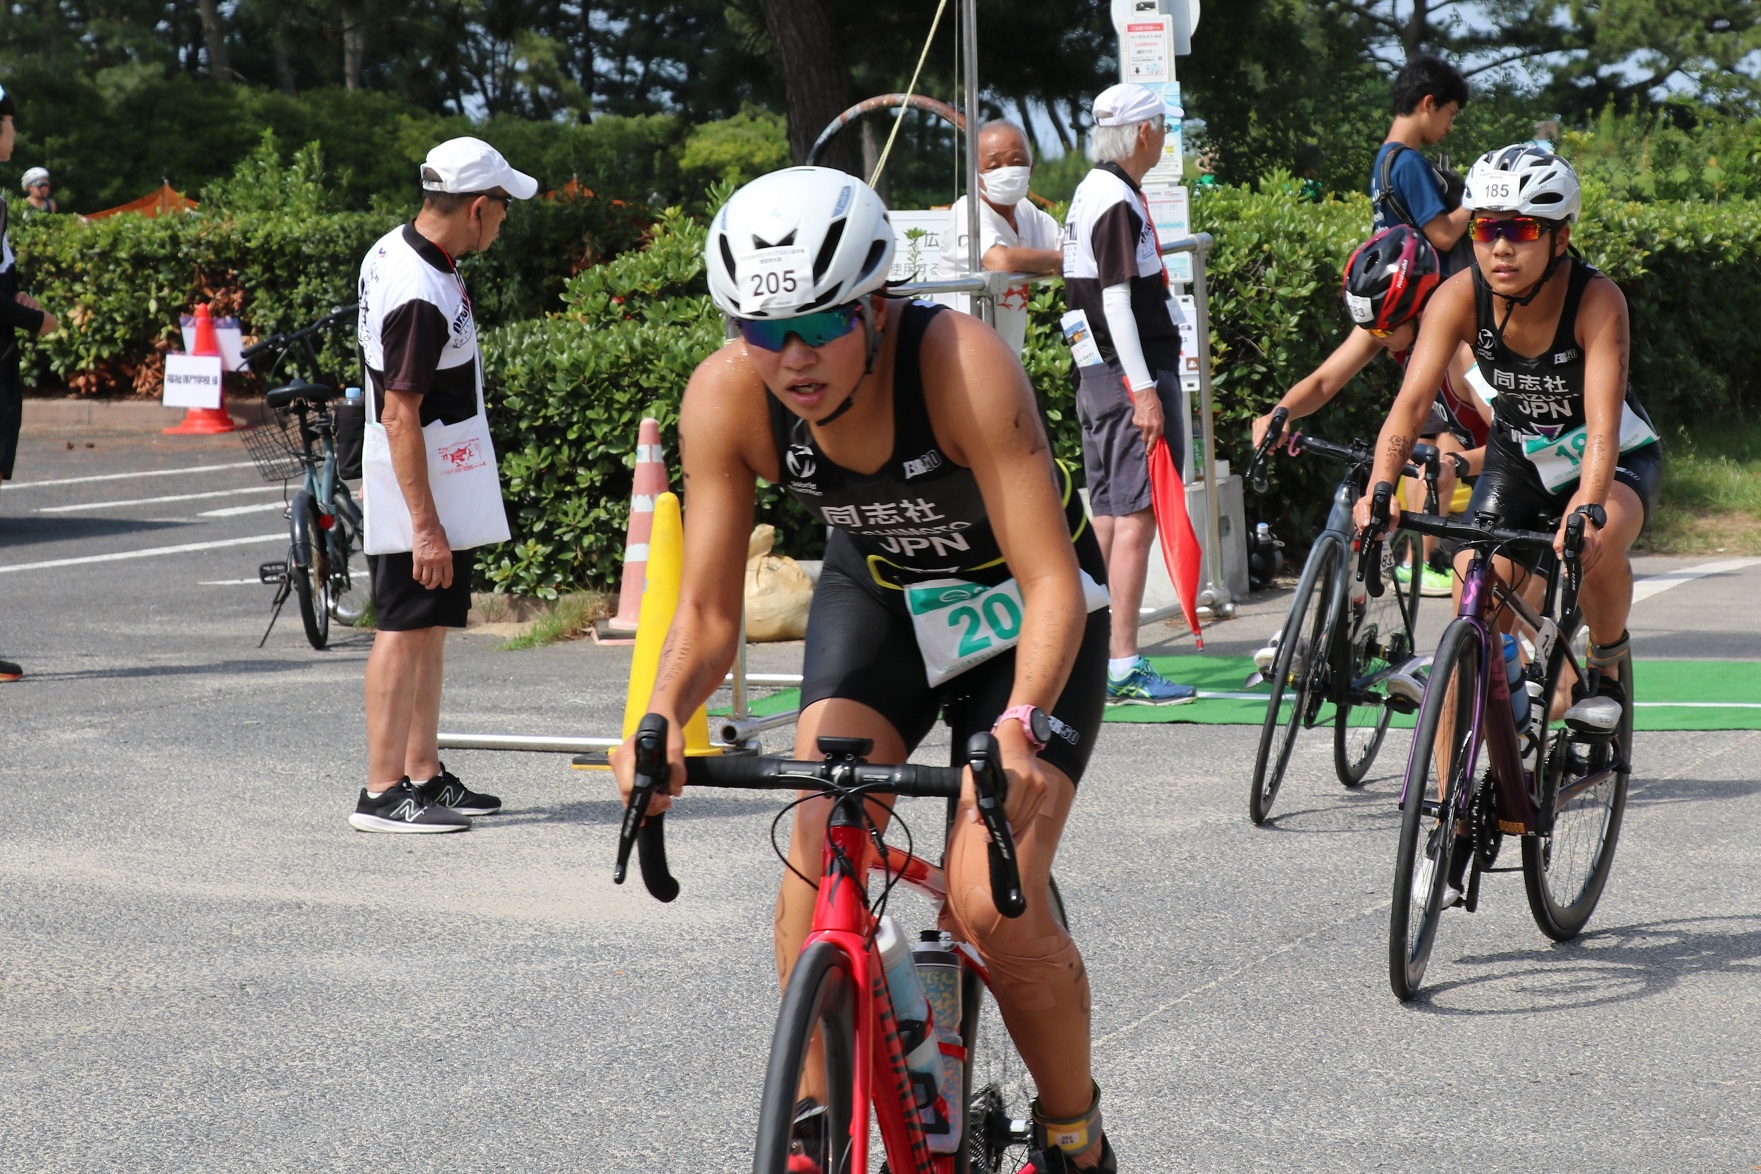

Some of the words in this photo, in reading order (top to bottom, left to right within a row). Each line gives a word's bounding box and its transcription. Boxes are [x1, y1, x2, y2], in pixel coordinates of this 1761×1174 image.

[1484, 183, 1510, 199] 185
[751, 269, 797, 297] 205
[1493, 368, 1570, 393] 同志社
[1518, 400, 1573, 419] JPN
[820, 498, 946, 528] 同志社
[878, 532, 972, 557] JPN
[1382, 554, 1394, 568] 83
[948, 584, 1026, 658] 20
